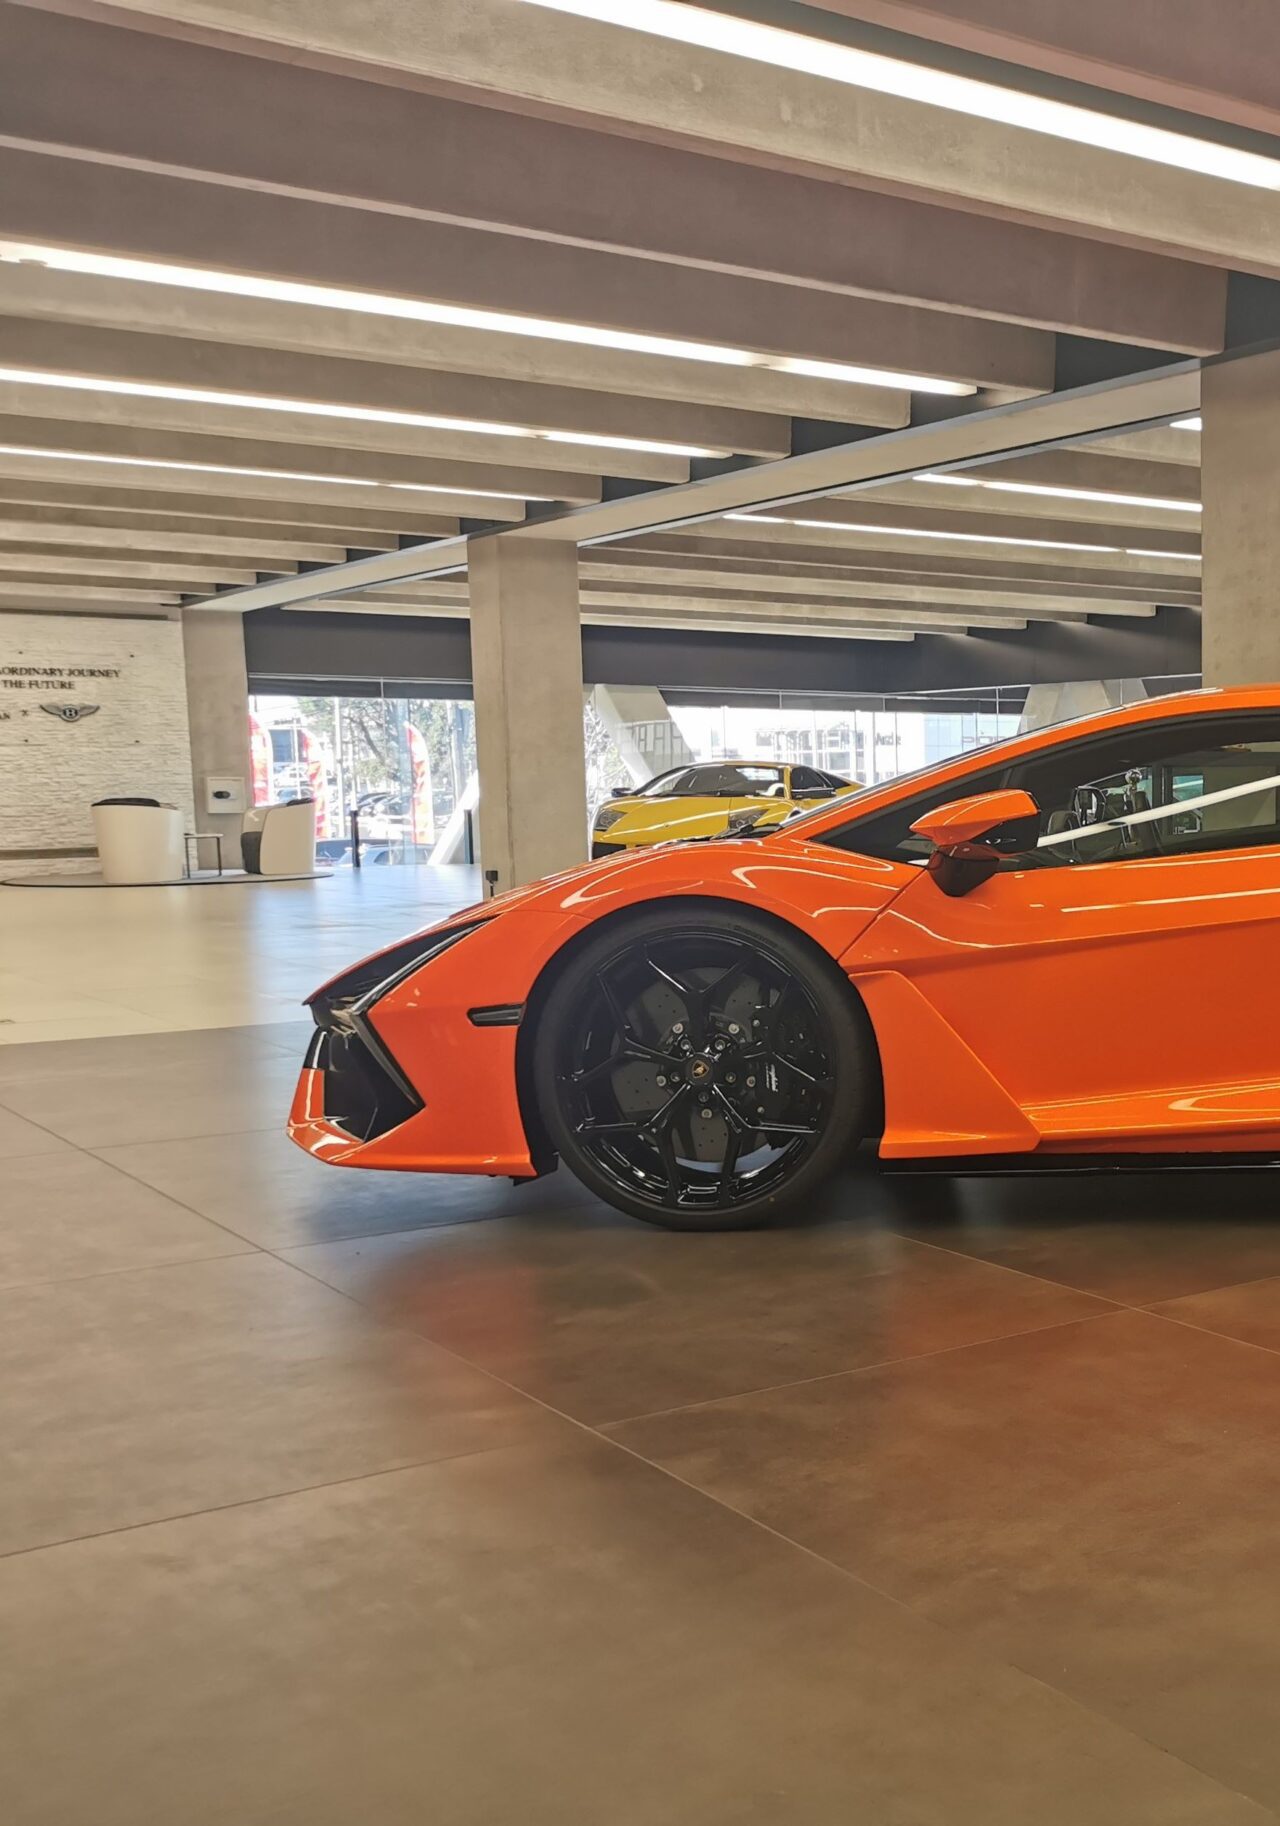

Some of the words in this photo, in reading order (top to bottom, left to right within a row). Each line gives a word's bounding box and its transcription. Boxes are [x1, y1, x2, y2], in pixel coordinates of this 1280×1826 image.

[0, 667, 63, 677] ORDINARY
[66, 668, 120, 678] JOURNEY
[3, 680, 26, 689] THE
[28, 680, 75, 689] FUTURE
